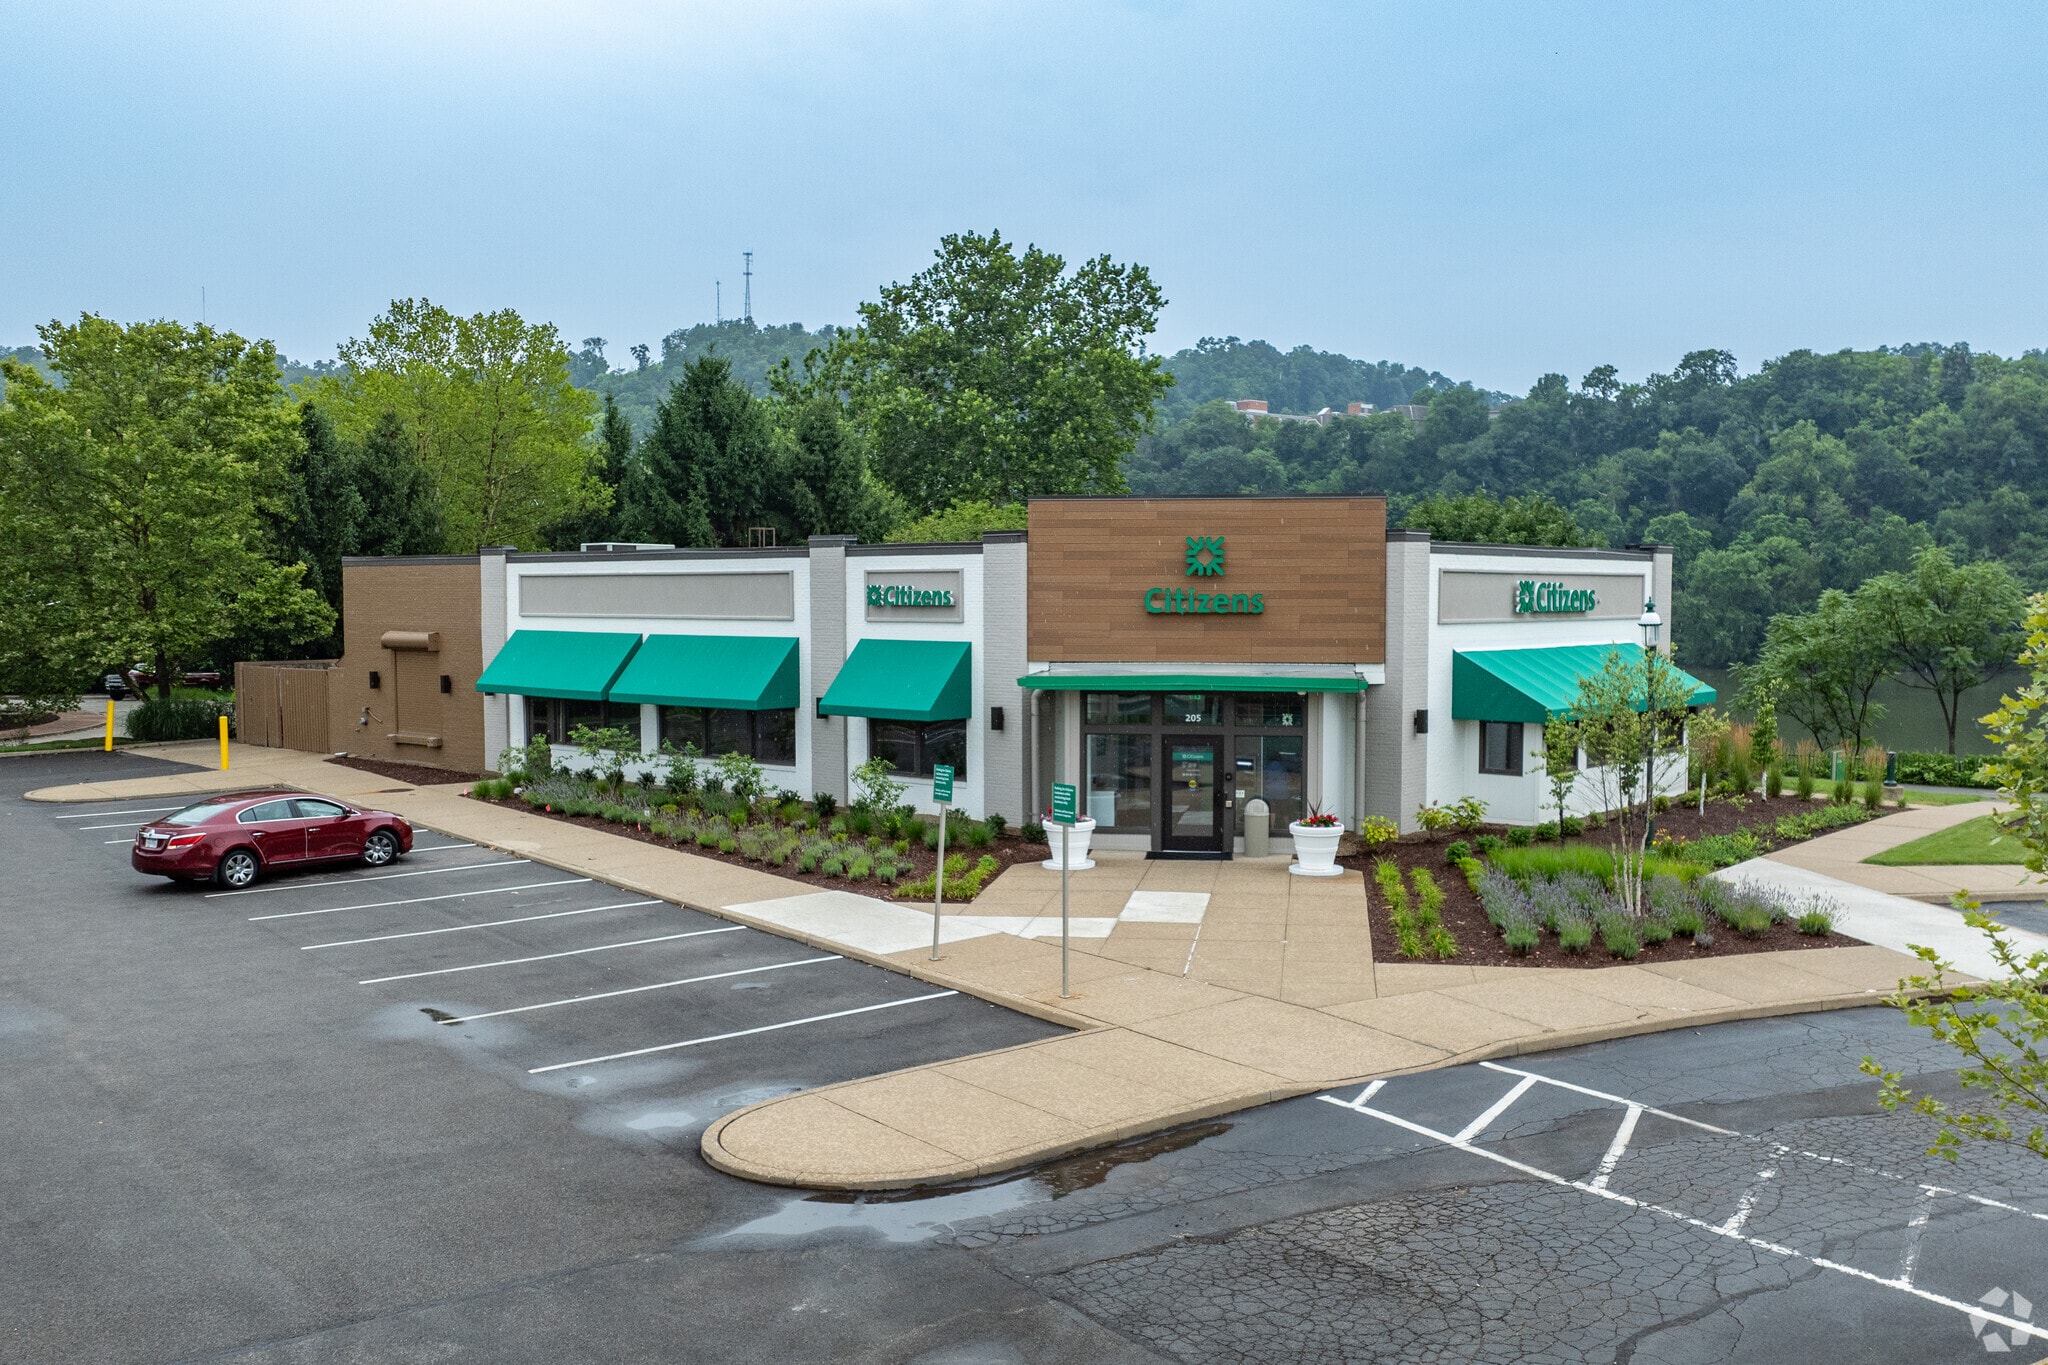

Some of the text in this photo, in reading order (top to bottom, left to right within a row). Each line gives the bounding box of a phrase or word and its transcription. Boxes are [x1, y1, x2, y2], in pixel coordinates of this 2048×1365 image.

[883, 585, 952, 606] Citizens
[1144, 587, 1265, 614] Citizens
[1536, 582, 1596, 612] Citizens
[1185, 714, 1202, 722] 205
